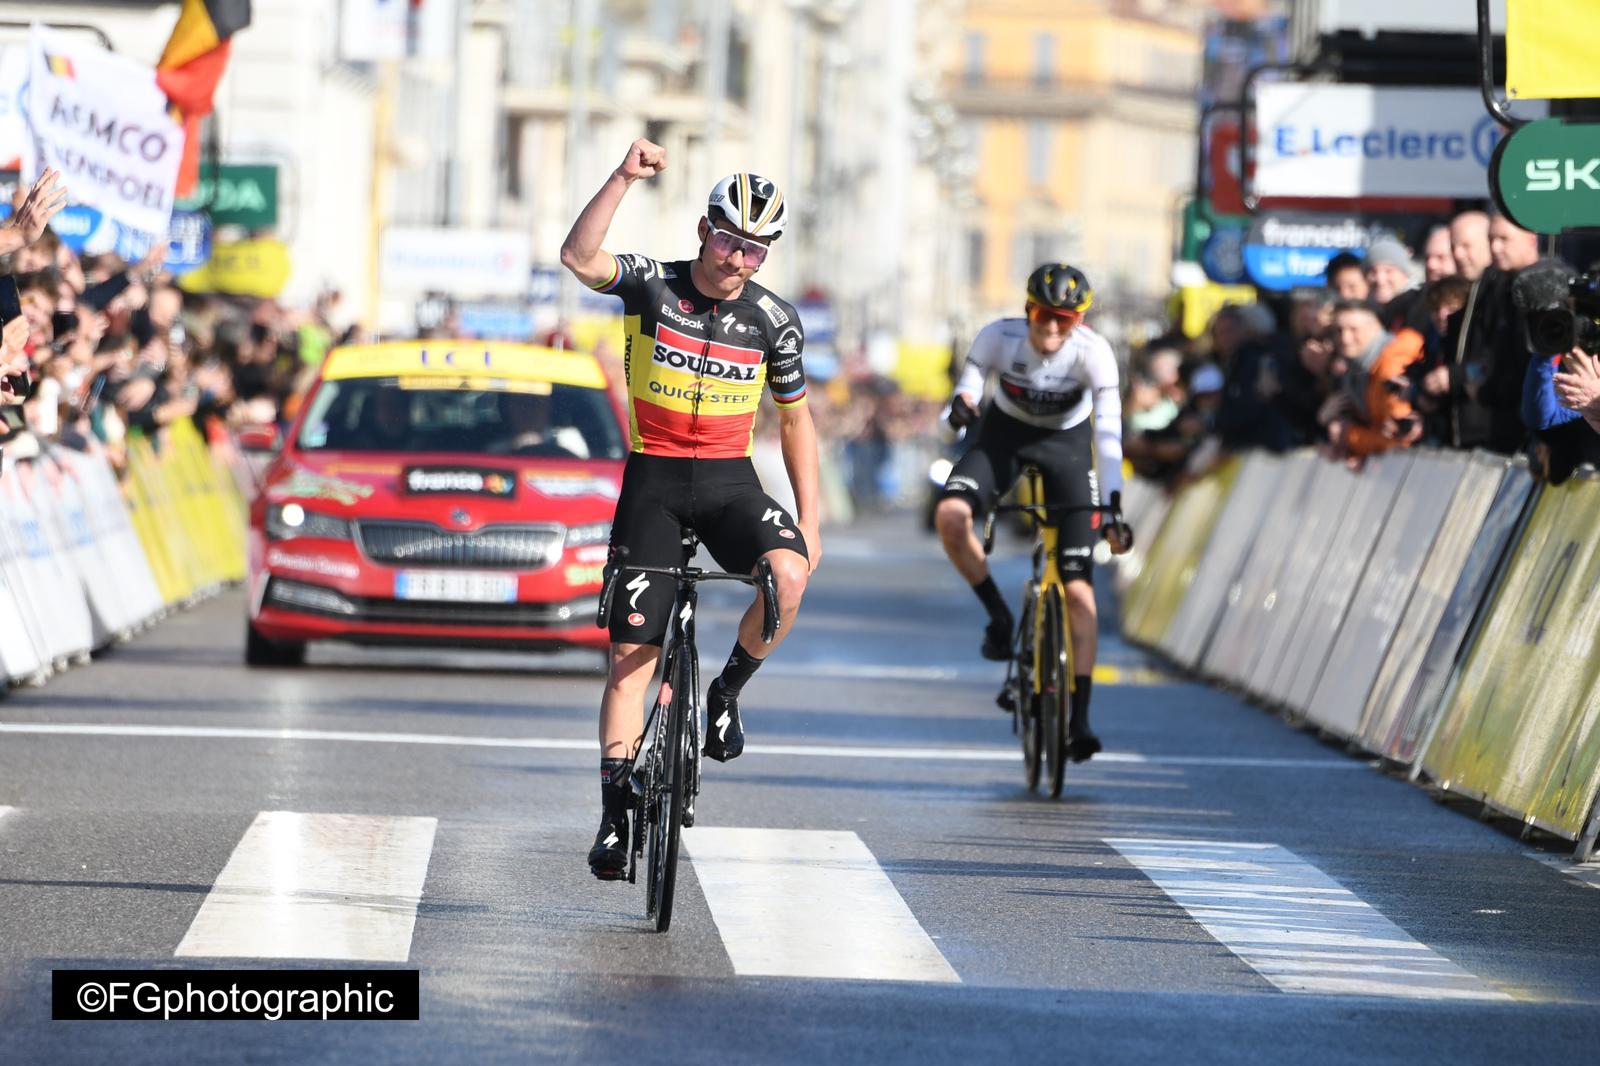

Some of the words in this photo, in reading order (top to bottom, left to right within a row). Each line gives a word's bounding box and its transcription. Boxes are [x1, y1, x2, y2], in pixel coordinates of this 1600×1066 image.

[1276, 126, 1466, 160] E.Leclerc
[661, 304, 705, 331] Ekopak
[653, 345, 757, 381] SOUDAL
